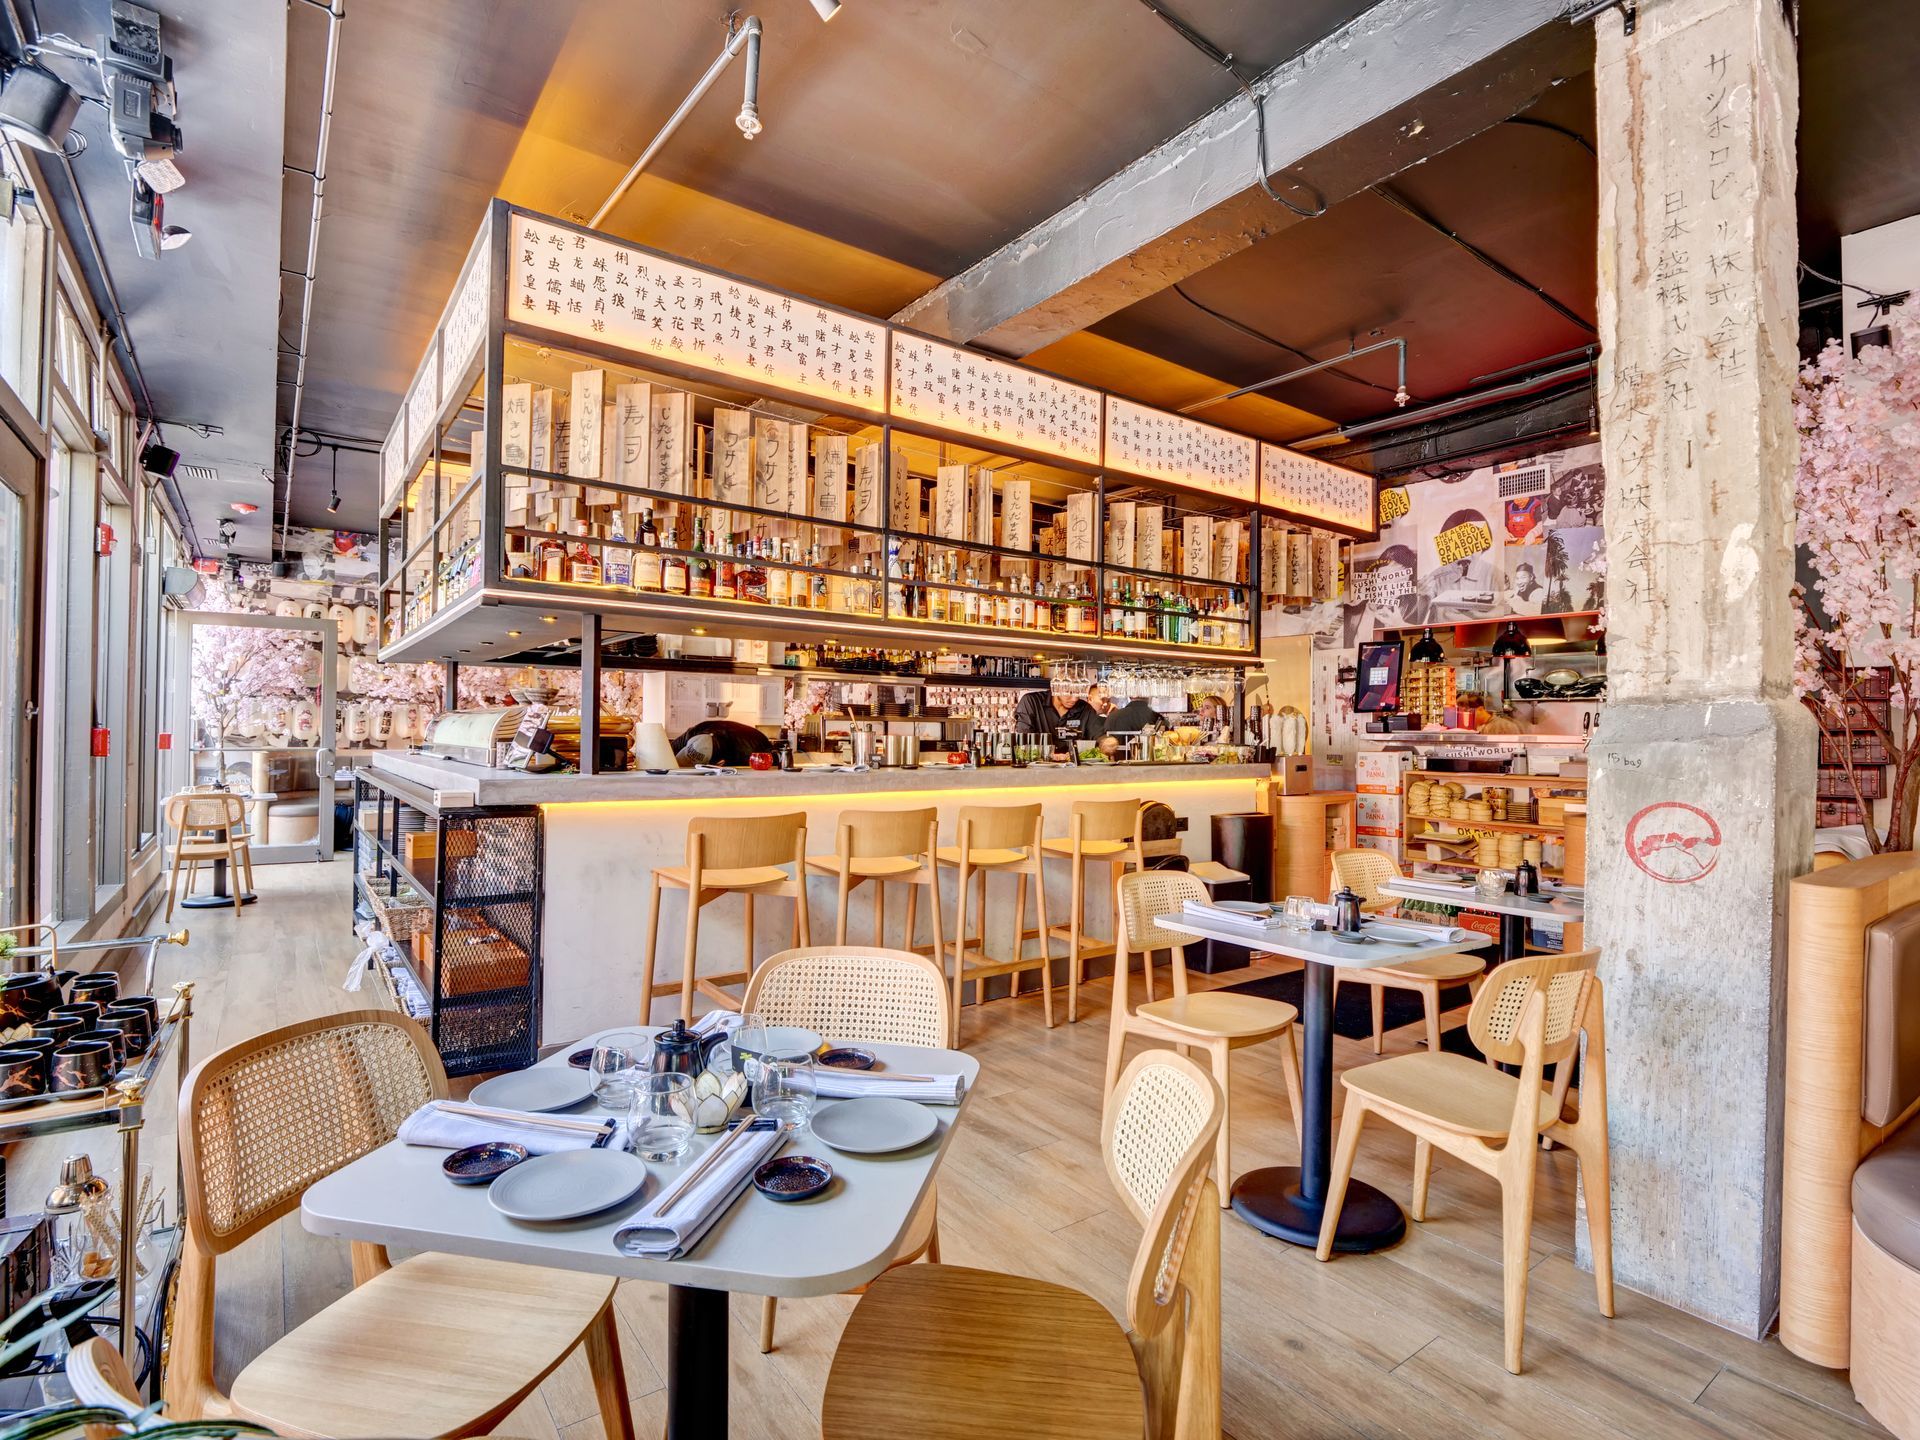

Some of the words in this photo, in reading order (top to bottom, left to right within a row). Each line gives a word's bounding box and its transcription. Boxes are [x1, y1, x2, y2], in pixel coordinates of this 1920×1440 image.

[1380, 496, 1404, 514] BOVE
[1436, 537, 1454, 548] FISH
[1438, 545, 1452, 557] OR
[1454, 530, 1486, 551] ABOVE
[1440, 553, 1459, 566] SEA
[1460, 538, 1491, 558] LEVELS
[1354, 579, 1378, 588] SUSHI
[1381, 569, 1412, 581] WORLD
[1391, 581, 1411, 589] LIKE
[1365, 592, 1382, 600] FISH
[1478, 748, 1514, 756] WORLD
[1624, 757, 1642, 768] bag
